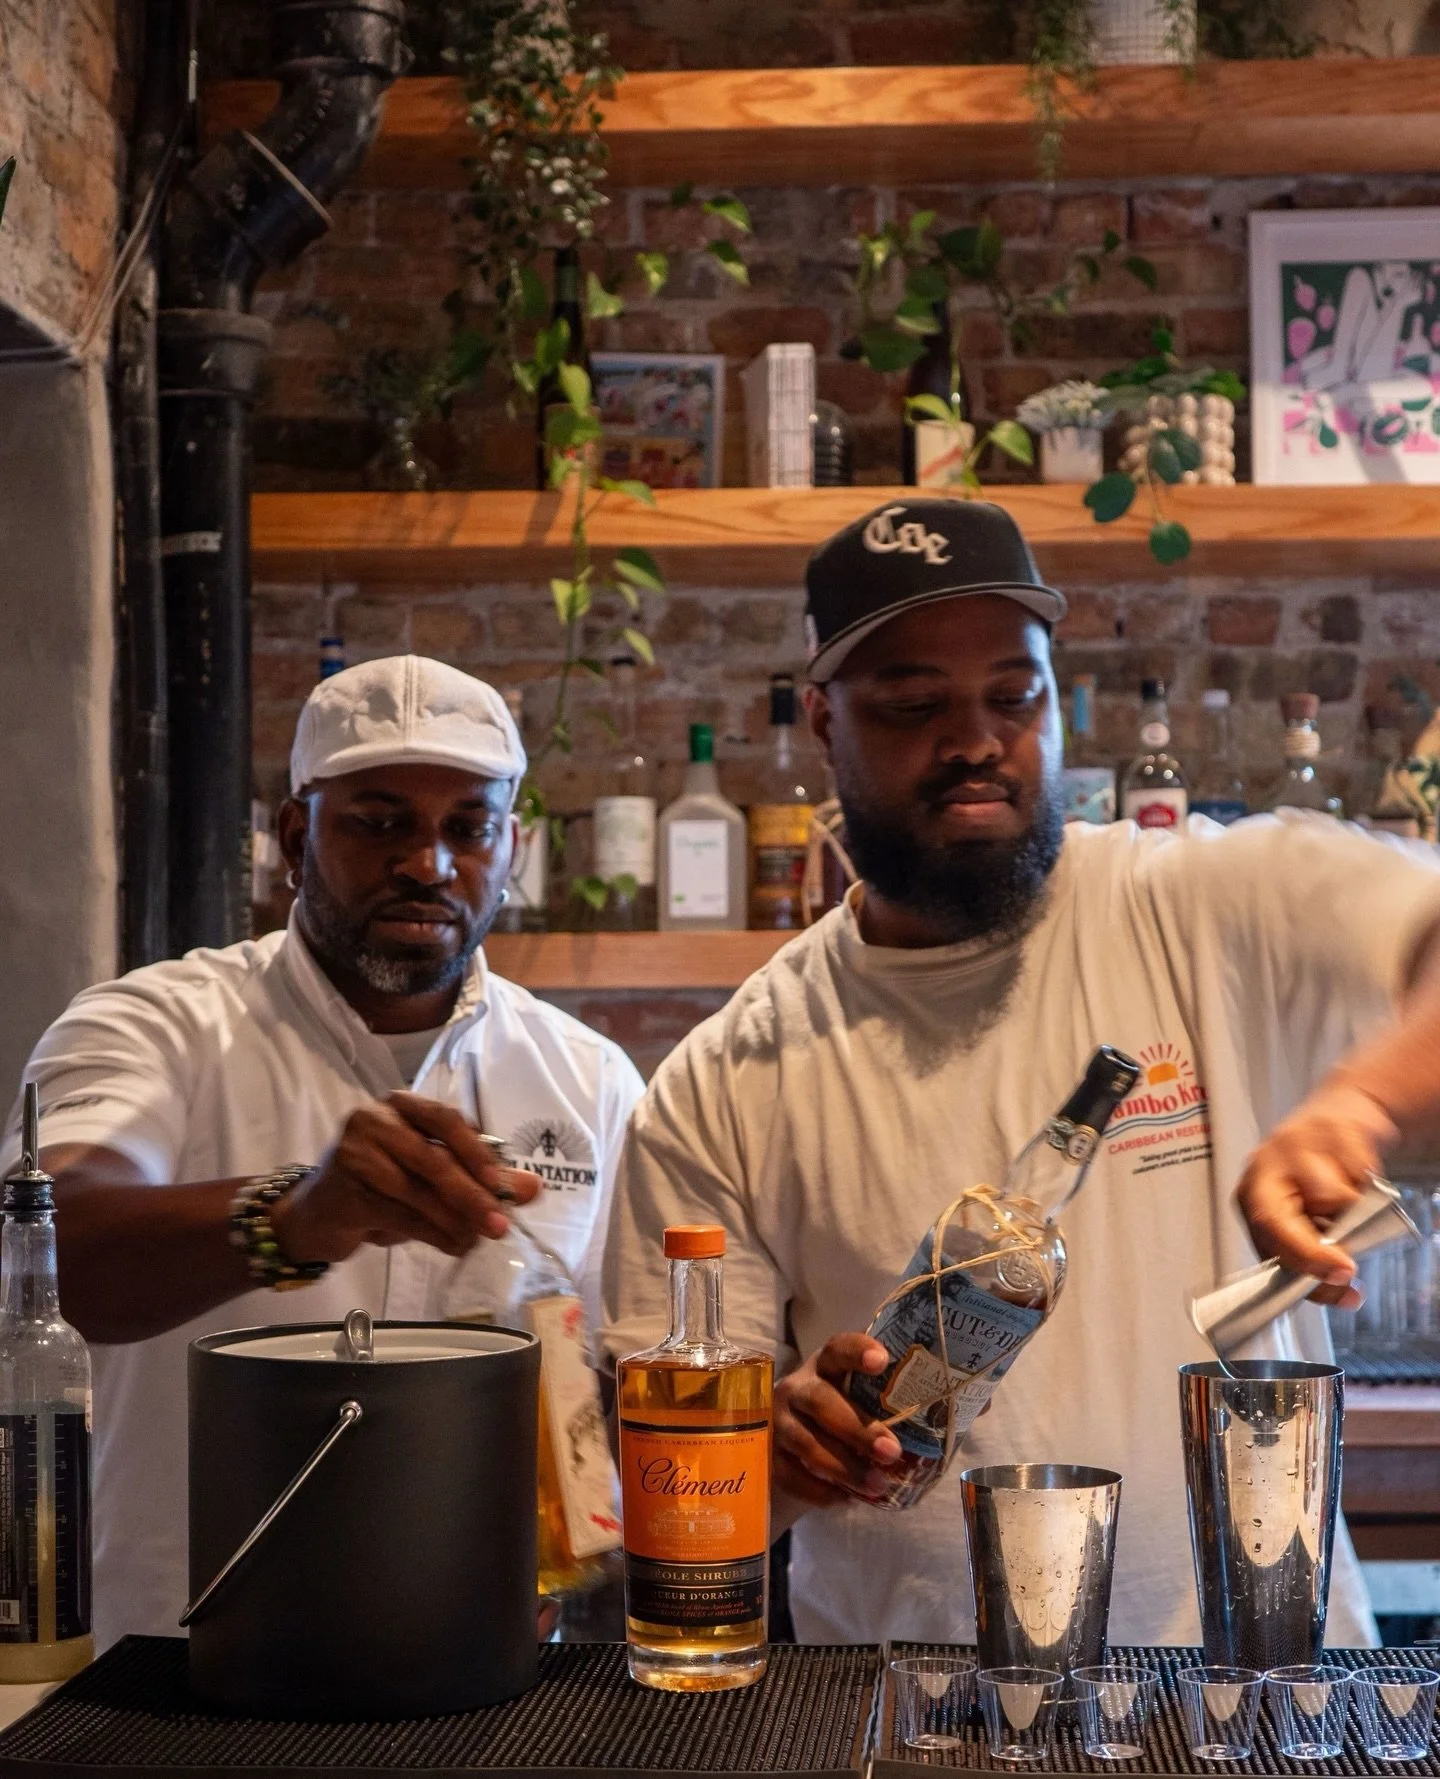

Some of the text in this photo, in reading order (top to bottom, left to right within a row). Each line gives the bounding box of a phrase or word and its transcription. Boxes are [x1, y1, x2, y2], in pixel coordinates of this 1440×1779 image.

[1108, 1130, 1174, 1155] CARIBBEAN
[664, 1439, 716, 1447] CARIBBEAN
[719, 1437, 755, 1446] LIQUEUR
[638, 1455, 747, 1496] Clément
